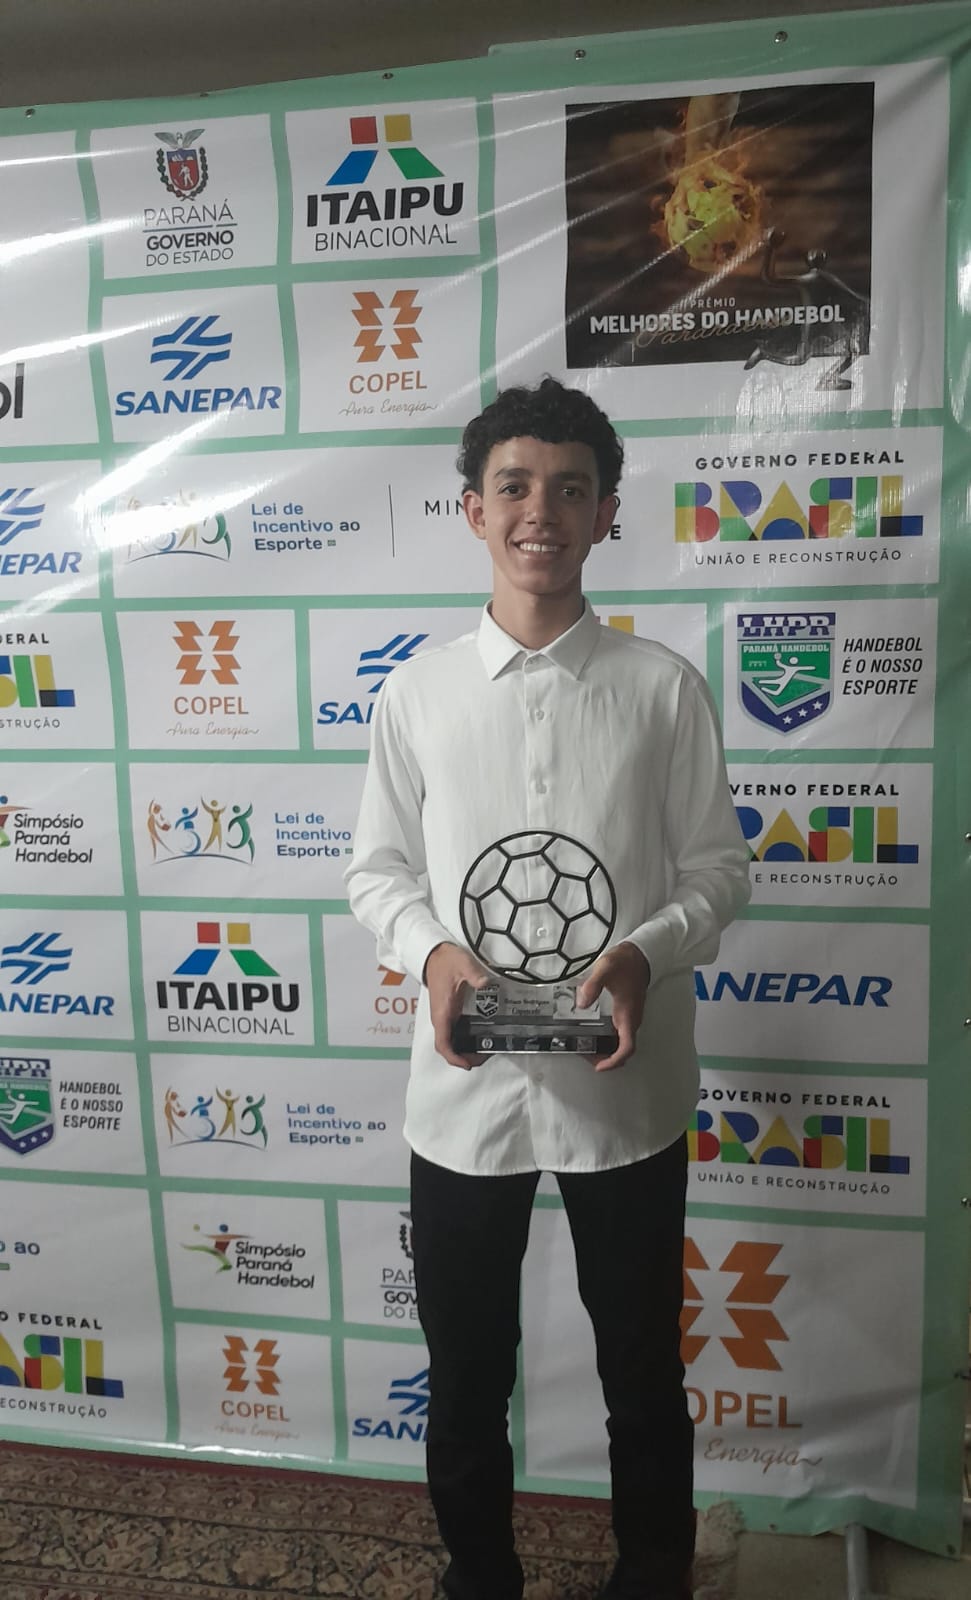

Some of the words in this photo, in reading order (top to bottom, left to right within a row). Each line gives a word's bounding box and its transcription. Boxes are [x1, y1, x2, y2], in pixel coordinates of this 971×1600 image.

[144, 198, 234, 226] PARANÁ
[306, 182, 464, 227] ITAIPU
[146, 230, 234, 250] GOVERNO
[315, 223, 457, 252] BINACIONAL
[146, 252, 168, 266] DO
[174, 248, 234, 264] ESTADO
[590, 311, 696, 334] MELHORES
[701, 310, 729, 329] DO
[735, 304, 846, 327] HANDEBOL
[349, 370, 427, 394] COPEL
[115, 386, 282, 416] SANEPAR
[696, 454, 797, 470] GOVERNO
[808, 451, 904, 466] FEDERAL
[252, 502, 277, 516] Lei
[283, 502, 303, 515] de
[674, 475, 924, 542] BRASIL
[253, 519, 334, 533] Incentivo
[340, 520, 360, 532] ao
[255, 538, 322, 552] Esporte
[695, 552, 745, 566] UNIÃO
[753, 554, 761, 564] E
[770, 550, 901, 564] RECONSTRUÇÃO
[742, 616, 830, 637] LHPR
[744, 644, 778, 652] PARANÁ
[781, 644, 829, 652] HANDEBOL
[843, 637, 923, 652] HANDEBOL
[842, 656, 851, 674] É
[857, 660, 866, 674] O
[870, 658, 923, 674] NOSSO
[842, 679, 919, 696] ESPORTE
[174, 696, 249, 716] COPEL
[808, 784, 899, 796] FEDERAL
[14, 814, 84, 830] Simpósio
[275, 812, 299, 824] Lei
[305, 812, 324, 824] de
[14, 830, 70, 846] Paraná
[276, 828, 351, 840] Incentivo
[15, 847, 92, 864] Handebol
[277, 844, 340, 858] Esporte
[755, 874, 762, 883] E
[770, 873, 898, 886] RECONSTRUÇÃO
[156, 980, 299, 1012] ITAIPU
[168, 1015, 294, 1036] BINACIONAL
[59, 1080, 122, 1095] HANDEBOL
[60, 1097, 68, 1110] É
[70, 1100, 78, 1112] O
[82, 1100, 123, 1113] NOSSO
[700, 1088, 792, 1104] GOVERNO
[802, 1094, 890, 1108] FEDERAL
[286, 1103, 312, 1115] Lei
[317, 1103, 335, 1116] de
[63, 1116, 120, 1130] ESPORTE
[288, 1118, 362, 1130] Incentivo
[368, 1121, 386, 1130] ao
[289, 1132, 351, 1146] Esporte
[687, 1110, 910, 1174] BRASIL
[698, 1172, 744, 1184] UNIÃO
[752, 1176, 758, 1184] E
[767, 1177, 890, 1195] RECONSTRUÇÃO
[15, 1241, 40, 1255] ao
[235, 1241, 305, 1258] Simpósio
[236, 1257, 292, 1271] Paraná
[238, 1273, 314, 1288] Handebol
[384, 1306, 405, 1318] DO
[18, 1312, 102, 1330] FEDERAL
[221, 1400, 290, 1422] COPEL
[704, 1438, 822, 1474] Energia
